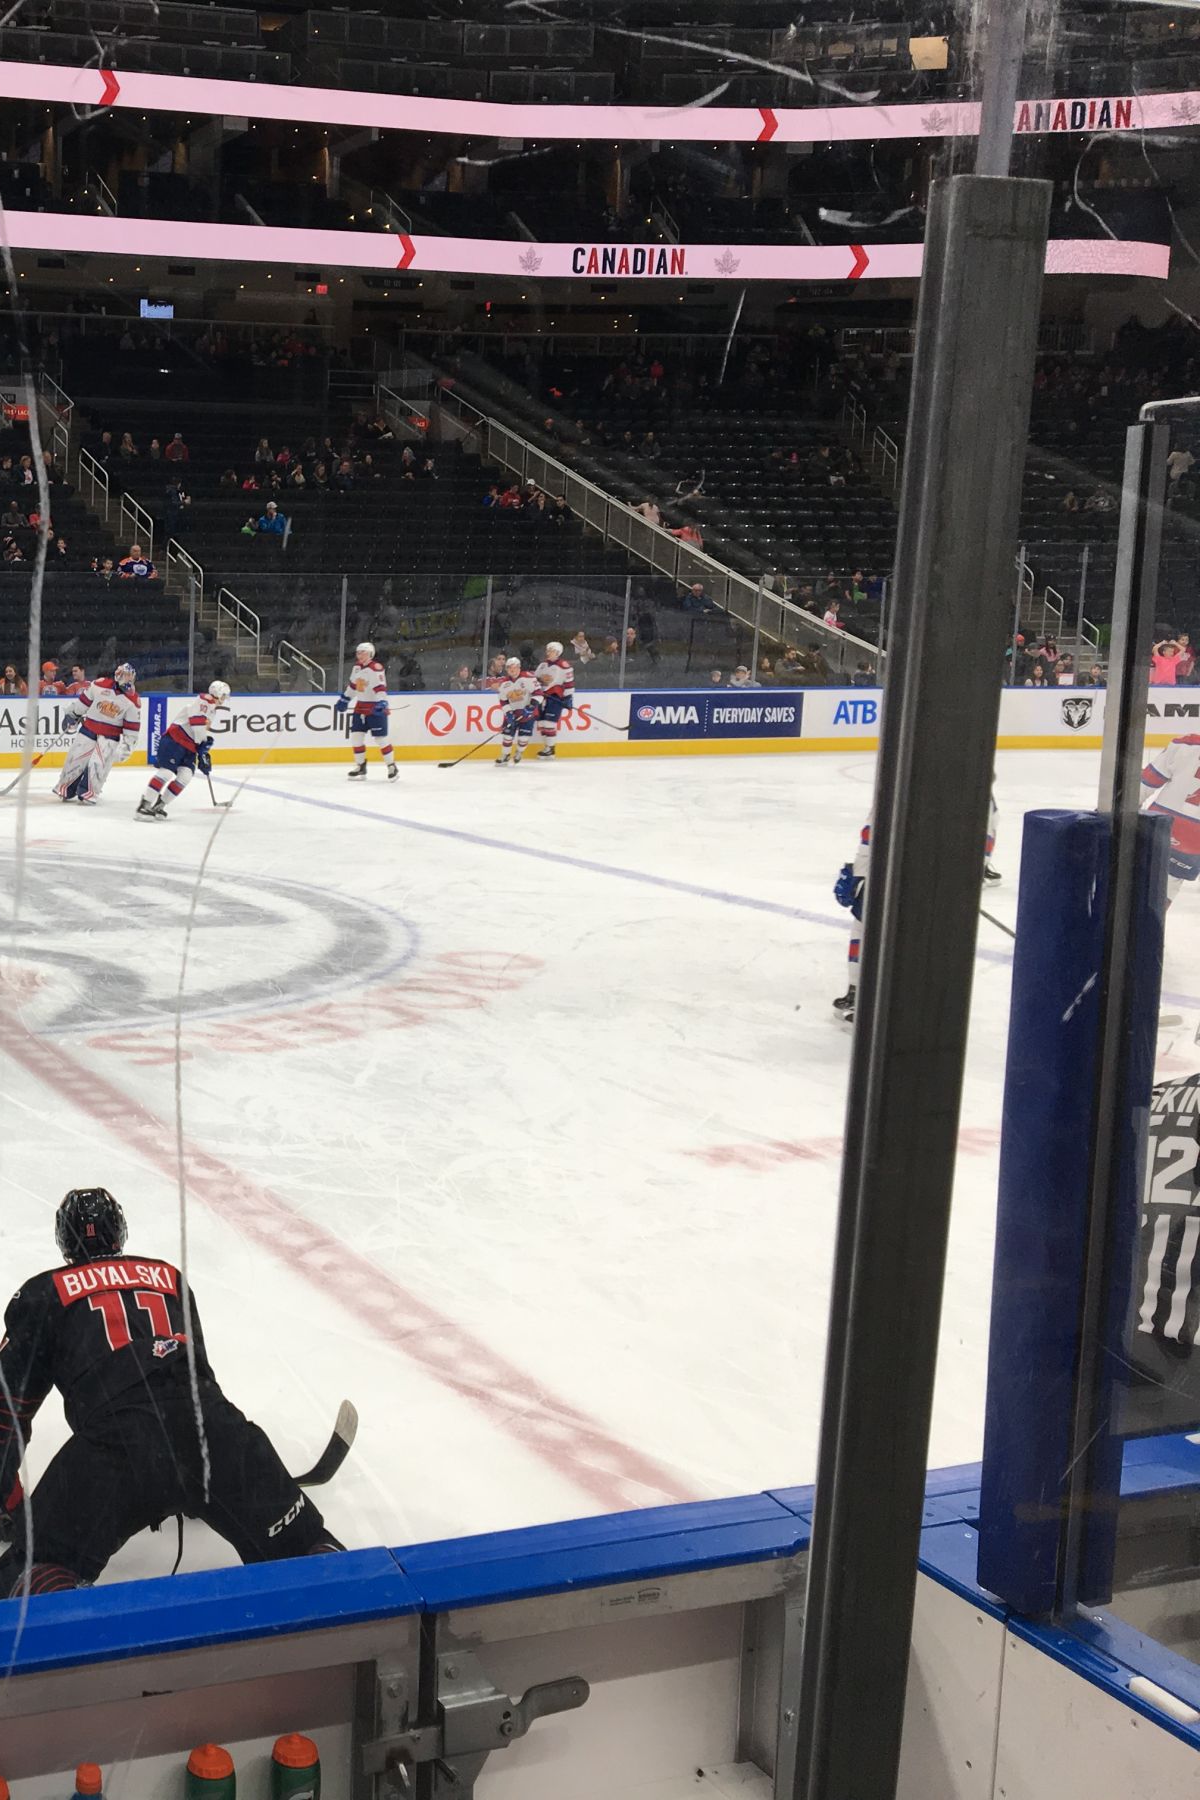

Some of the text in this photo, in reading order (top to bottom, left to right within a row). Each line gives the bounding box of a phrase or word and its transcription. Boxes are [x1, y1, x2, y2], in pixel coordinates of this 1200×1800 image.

[1017, 99, 1132, 132] ANADIAN
[572, 247, 685, 275] CANADIAN
[209, 705, 297, 734] Great
[465, 703, 592, 733] RORS
[650, 705, 700, 725] AMA
[712, 706, 796, 725] EVERYDAY SAVES
[833, 699, 877, 725] ATB
[1146, 703, 1200, 718] AM
[10, 738, 76, 749] HOESTOR
[62, 1264, 174, 1297] BUYALSKI
[88, 1290, 175, 1352] 11
[267, 1492, 305, 1538] CCM
